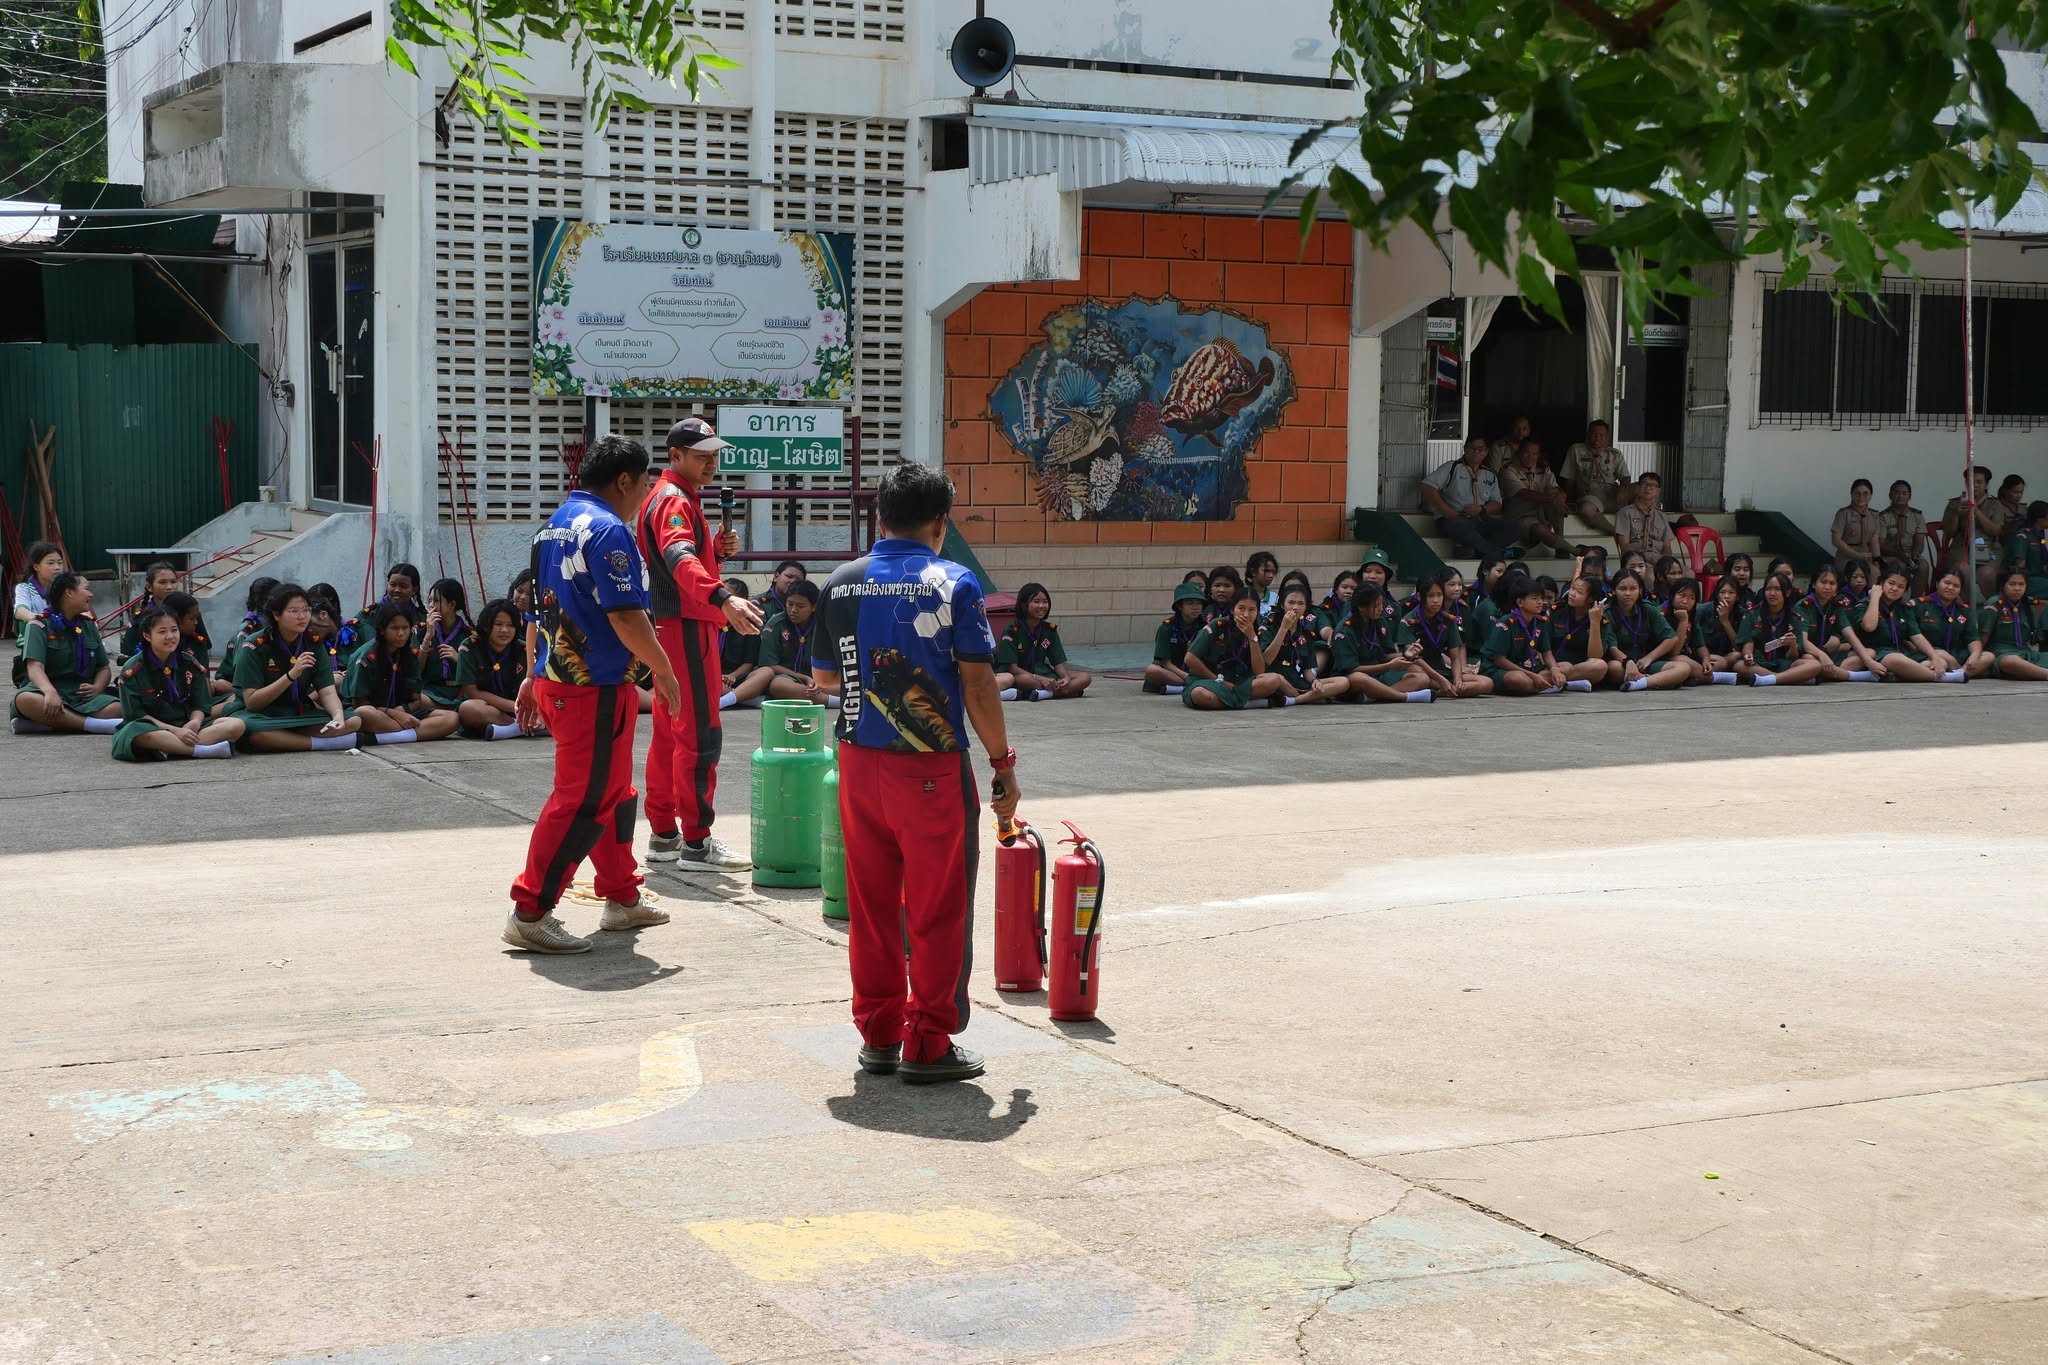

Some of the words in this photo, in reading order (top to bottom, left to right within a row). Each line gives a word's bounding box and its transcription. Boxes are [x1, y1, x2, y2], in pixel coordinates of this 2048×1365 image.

[603, 245, 700, 264] โรงเรียนเทศบาล
[764, 316, 812, 329] เอกลักษณ์
[747, 414, 817, 432] อาคาร
[616, 584, 631, 592] 199
[831, 578, 936, 603] เทศบาลเมืองเพชรบูรณ์
